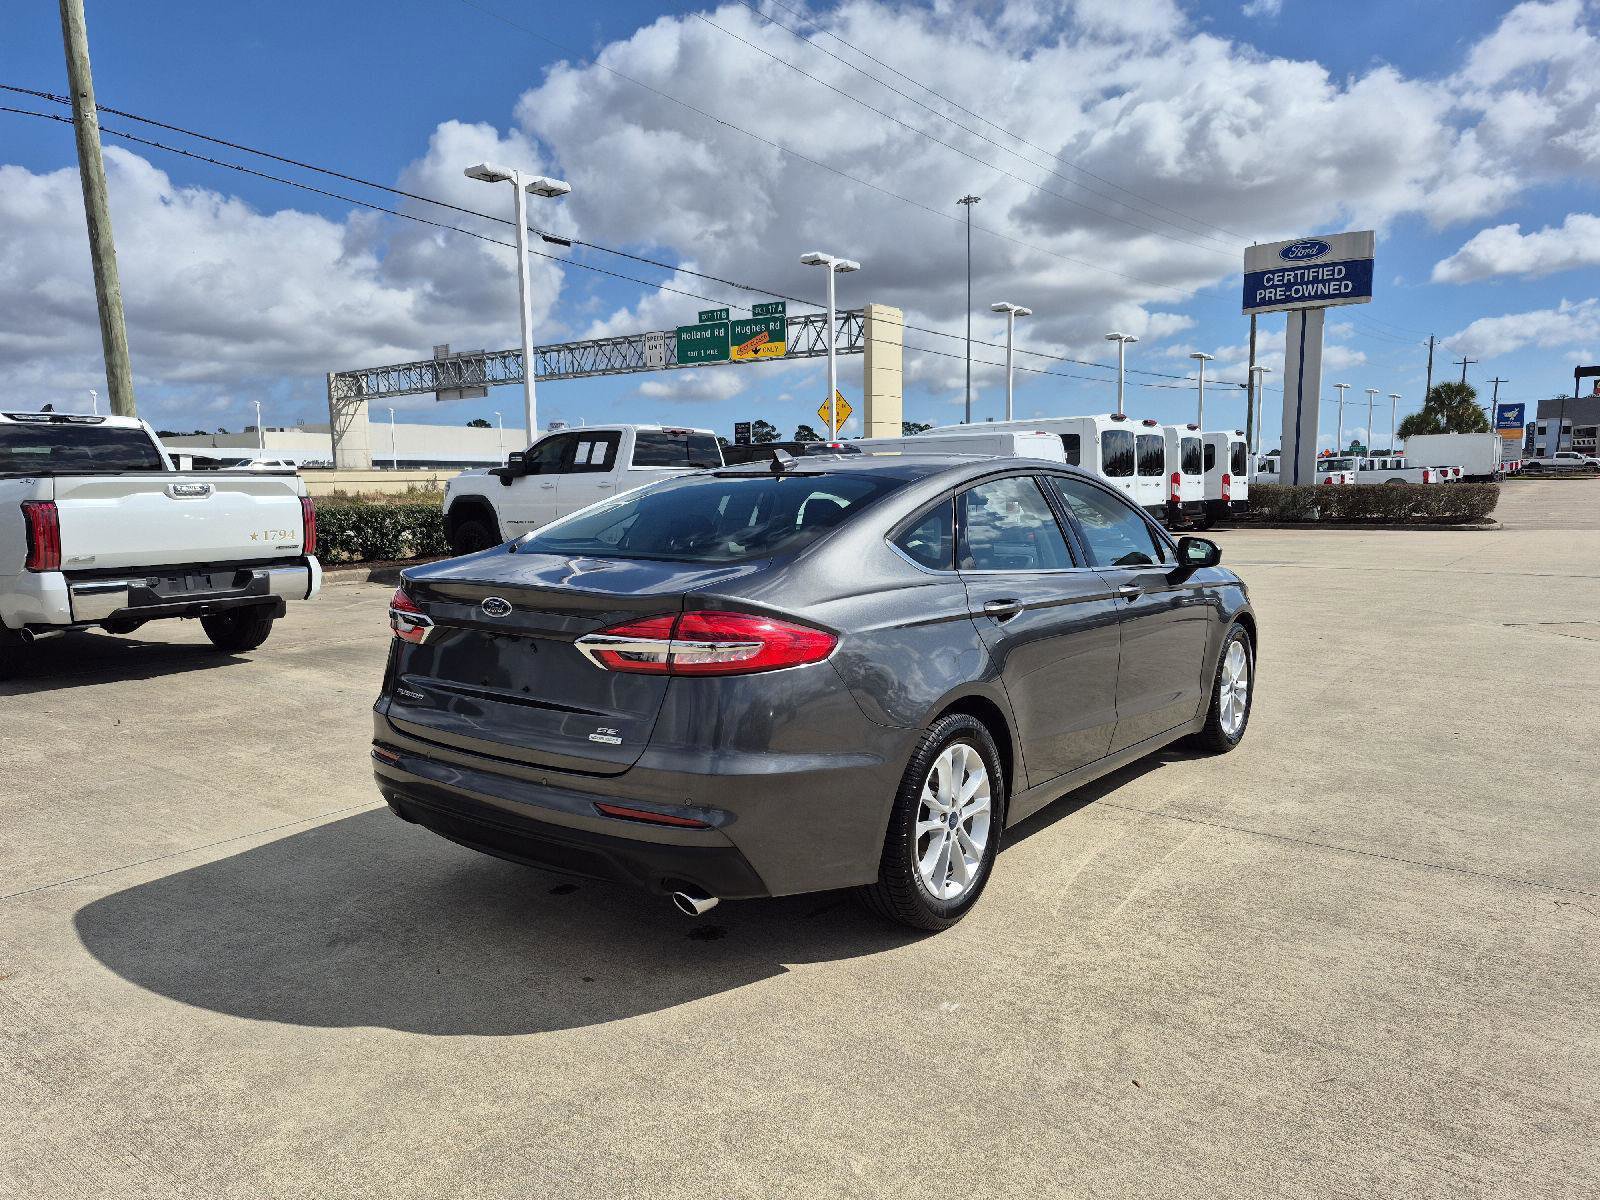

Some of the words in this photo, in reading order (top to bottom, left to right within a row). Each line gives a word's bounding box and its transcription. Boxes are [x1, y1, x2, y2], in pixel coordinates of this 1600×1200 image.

[1289, 243, 1319, 257] Ford
[1263, 265, 1346, 287] CERTIFIED
[1256, 280, 1353, 302] PRE-OWNED
[681, 328, 711, 341] Holland
[714, 327, 725, 337] Rd
[735, 323, 766, 335] Hughes
[769, 320, 780, 331] Rd
[646, 335, 664, 343] SPEED
[700, 349, 705, 357] 1
[762, 345, 779, 353] ONLY
[263, 529, 297, 541] 1794
[596, 727, 619, 735] SE
